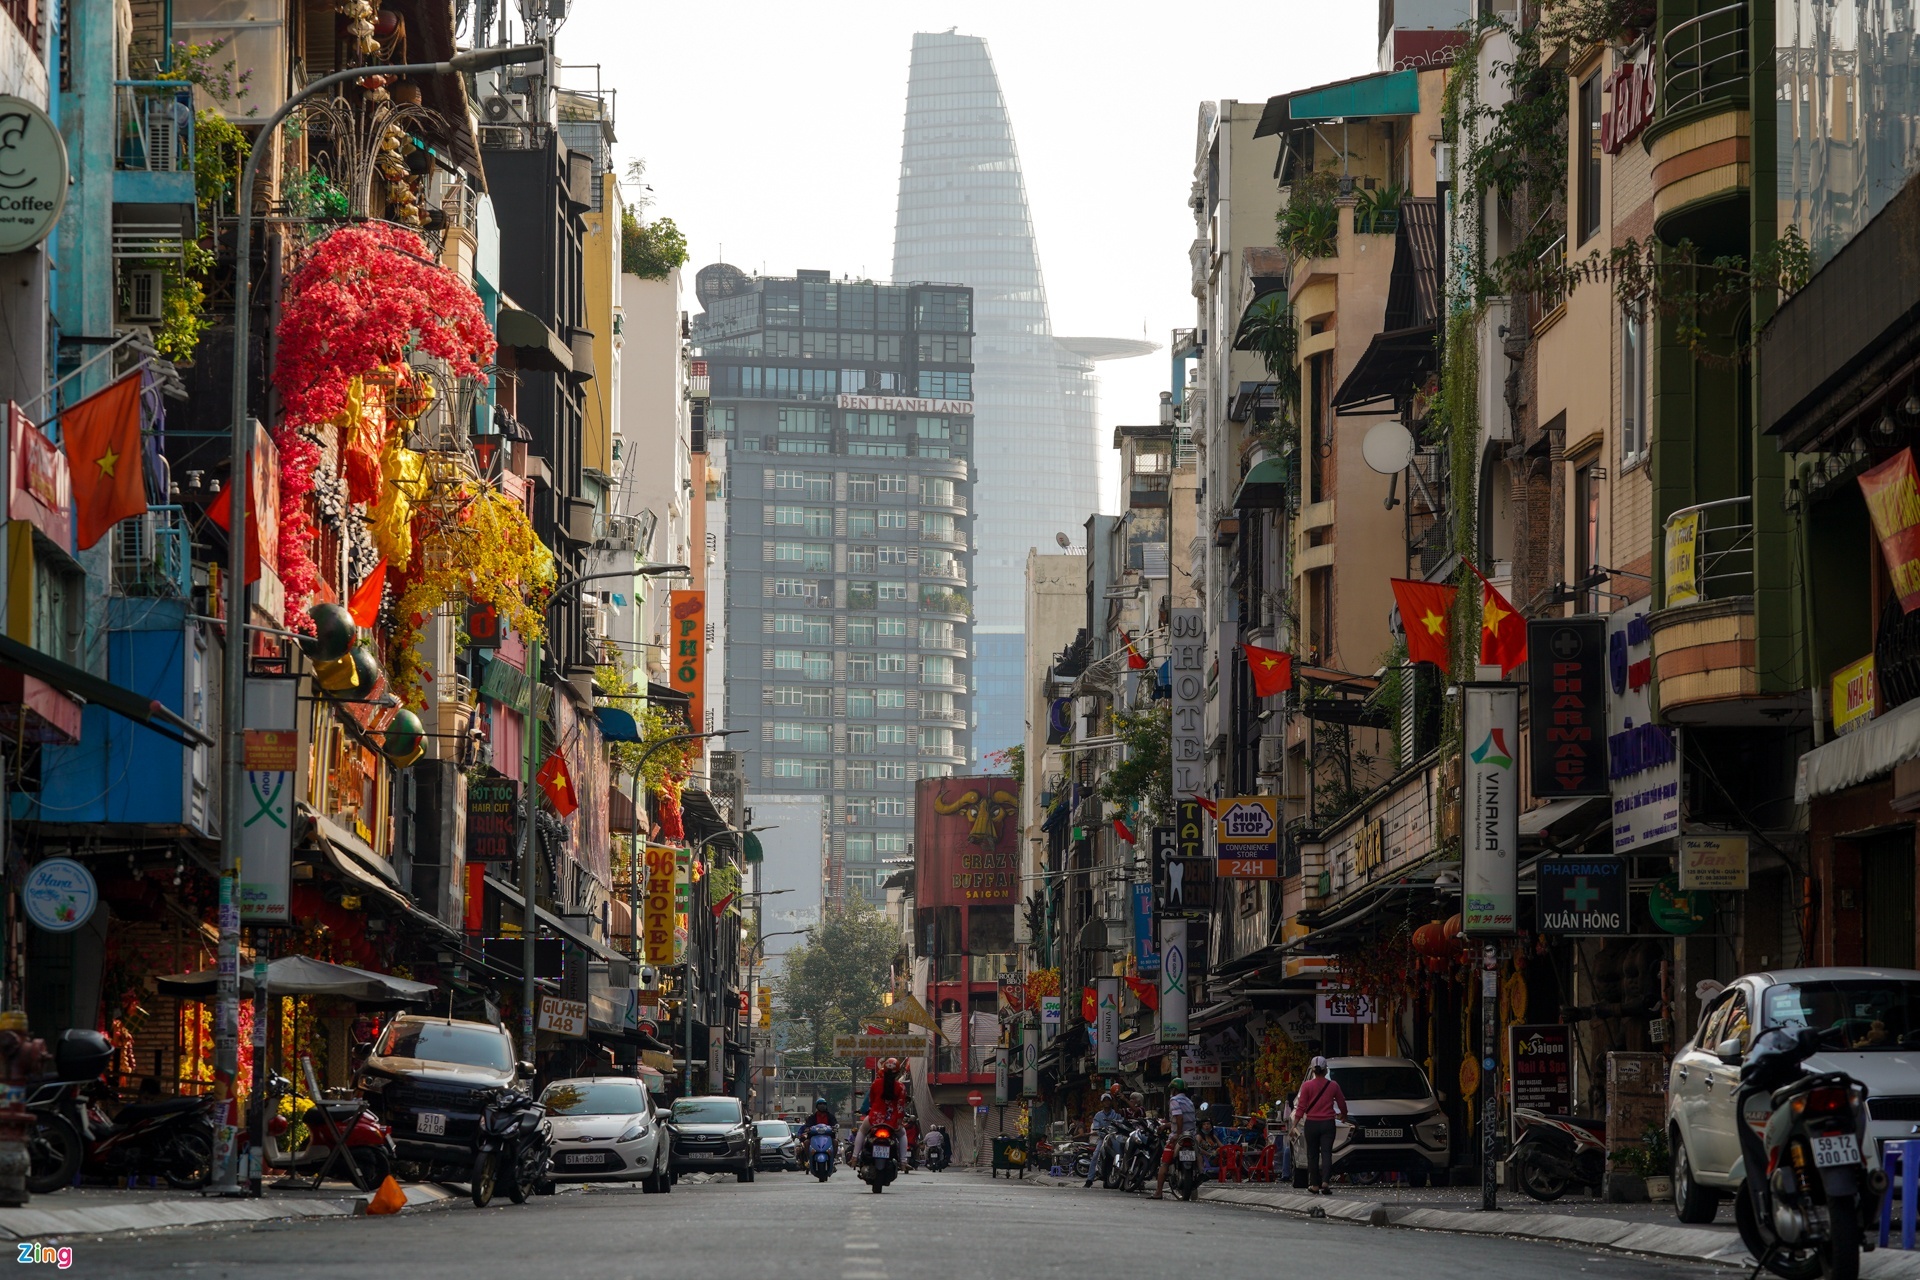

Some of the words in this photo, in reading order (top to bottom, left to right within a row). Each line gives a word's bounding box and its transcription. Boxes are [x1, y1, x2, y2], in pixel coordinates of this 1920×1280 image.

[18, 217, 35, 225] egg
[840, 395, 869, 410] BEN
[872, 396, 928, 412] THANH
[932, 399, 973, 415] LAND
[1173, 615, 1202, 637] 99
[1174, 645, 1201, 792] HOTEL
[1547, 662, 1592, 790] PHARMACY
[262, 771, 271, 796] ROUP
[492, 784, 513, 800] TÓC
[471, 803, 491, 813] HAIR
[494, 803, 509, 813] CUT
[1233, 812, 1262, 822] MINI
[469, 815, 513, 836] TRUNG
[1232, 822, 1263, 833] STOP
[646, 850, 674, 877] 96
[962, 853, 1020, 869] CRAZY
[1231, 861, 1263, 875] 24H
[1543, 864, 1620, 876] PHARMACY
[965, 890, 1009, 899] SAIGON
[649, 879, 669, 962] HOTEL
[1544, 909, 1580, 929] XUÂN
[1583, 909, 1620, 929] HỒNG
[566, 1003, 585, 1020] XE
[1335, 1005, 1361, 1013] STP
[548, 1015, 574, 1032] 148
[1288, 1021, 1317, 1032] Tiger
[1517, 1060, 1536, 1074] Nail
[1549, 1060, 1567, 1074] Spa
[424, 1114, 439, 1125] 51D
[1818, 1136, 1852, 1151] 59-T2
[1817, 1149, 1859, 1165] 300.10
